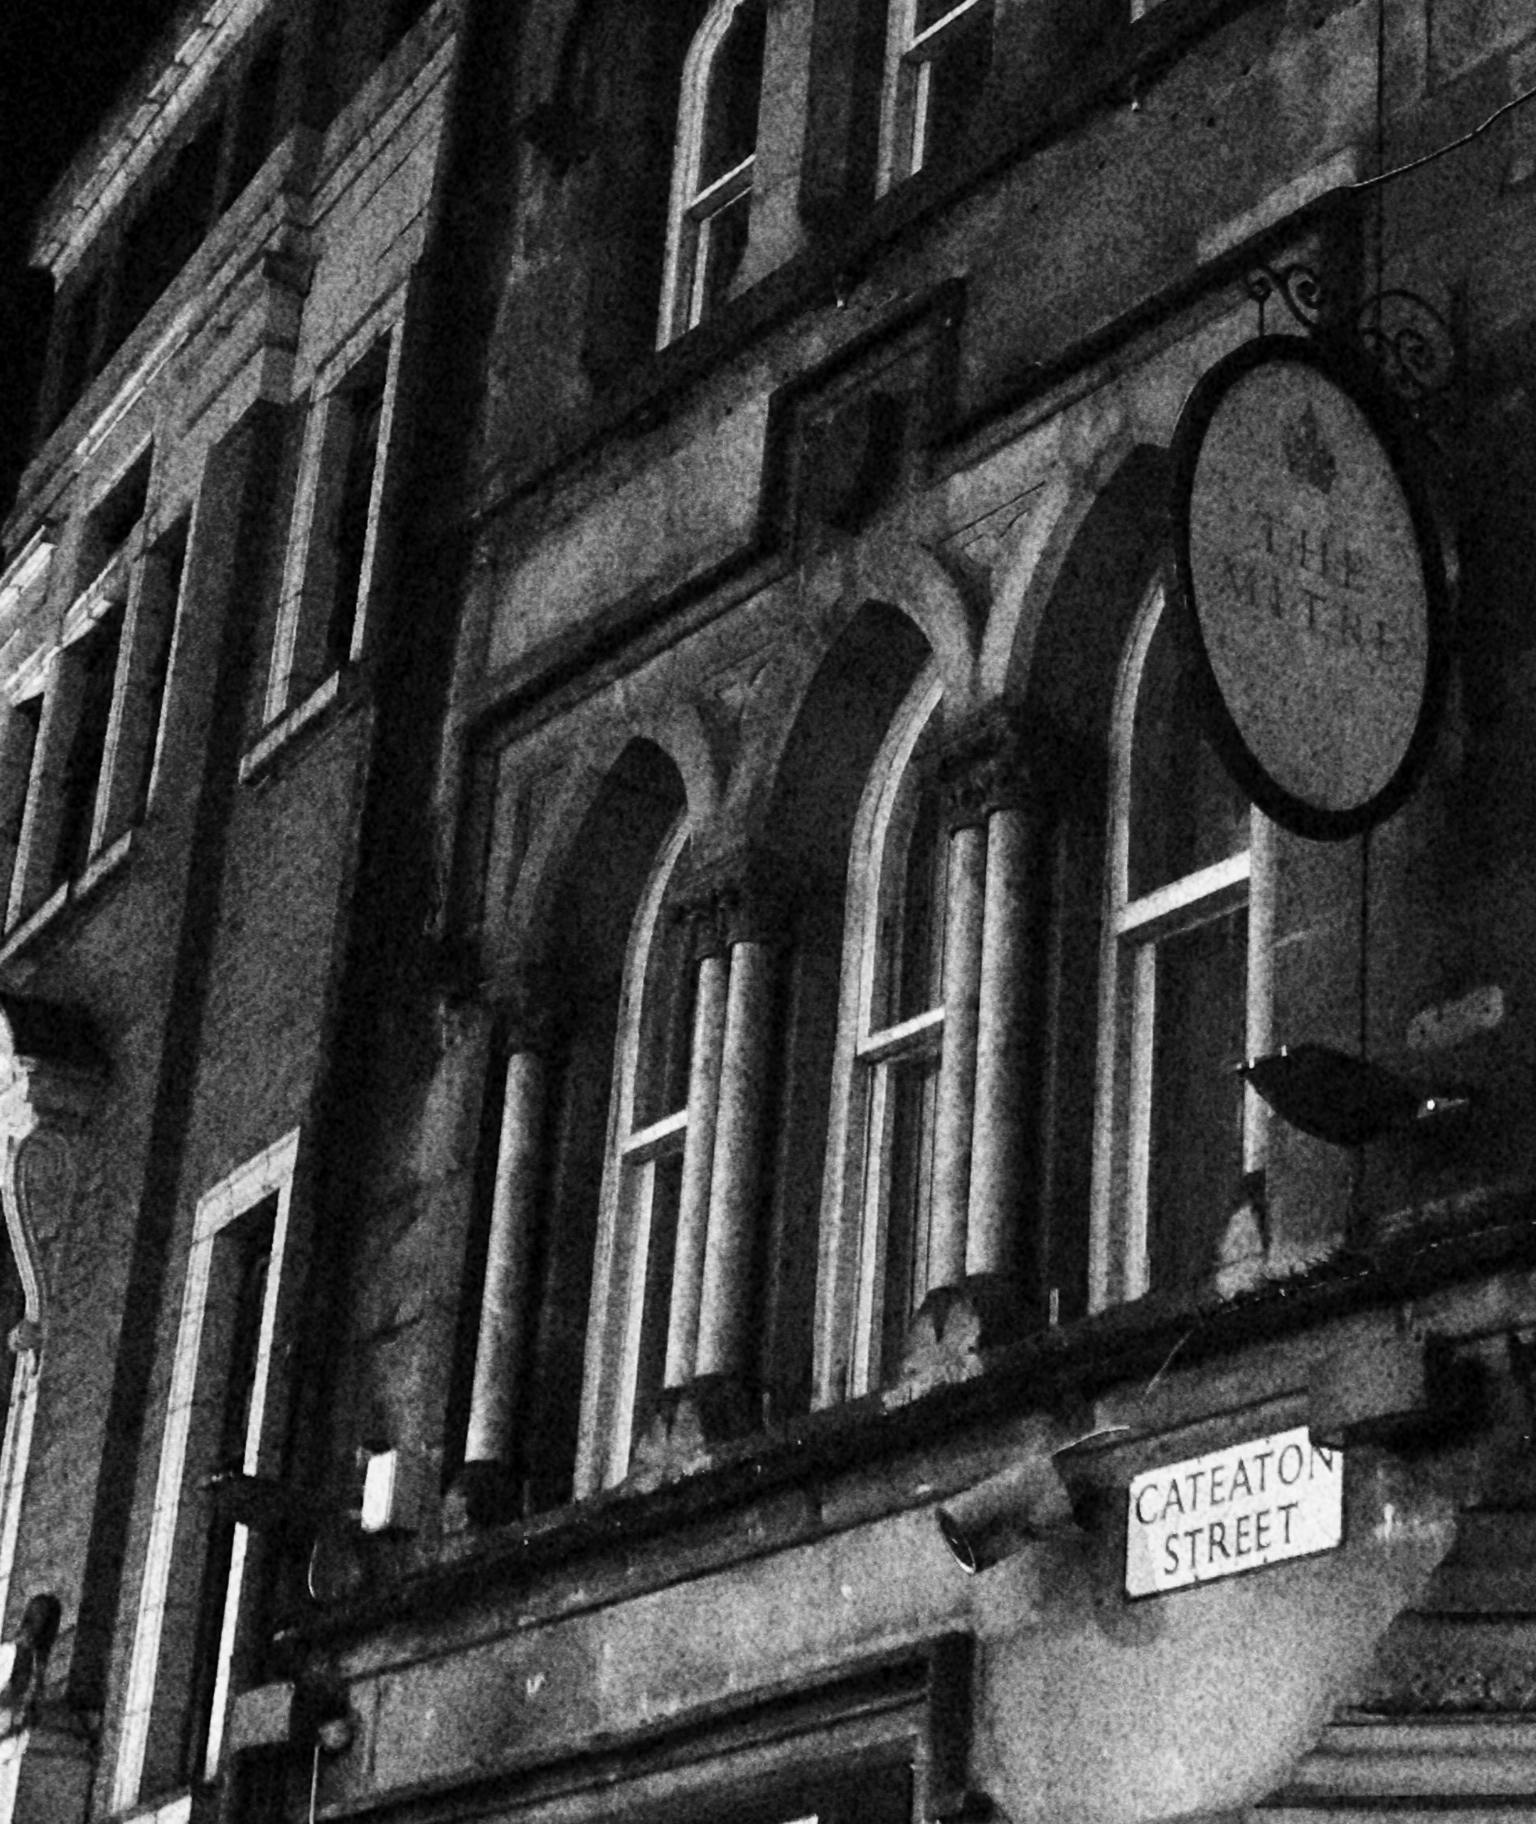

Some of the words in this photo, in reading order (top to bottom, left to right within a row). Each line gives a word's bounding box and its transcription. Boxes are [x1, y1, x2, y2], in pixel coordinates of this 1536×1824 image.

[1250, 510, 1367, 594] THE
[1221, 552, 1403, 667] MITRE
[1134, 1442, 1334, 1525] CATEATON
[1163, 1502, 1299, 1576] STREET
